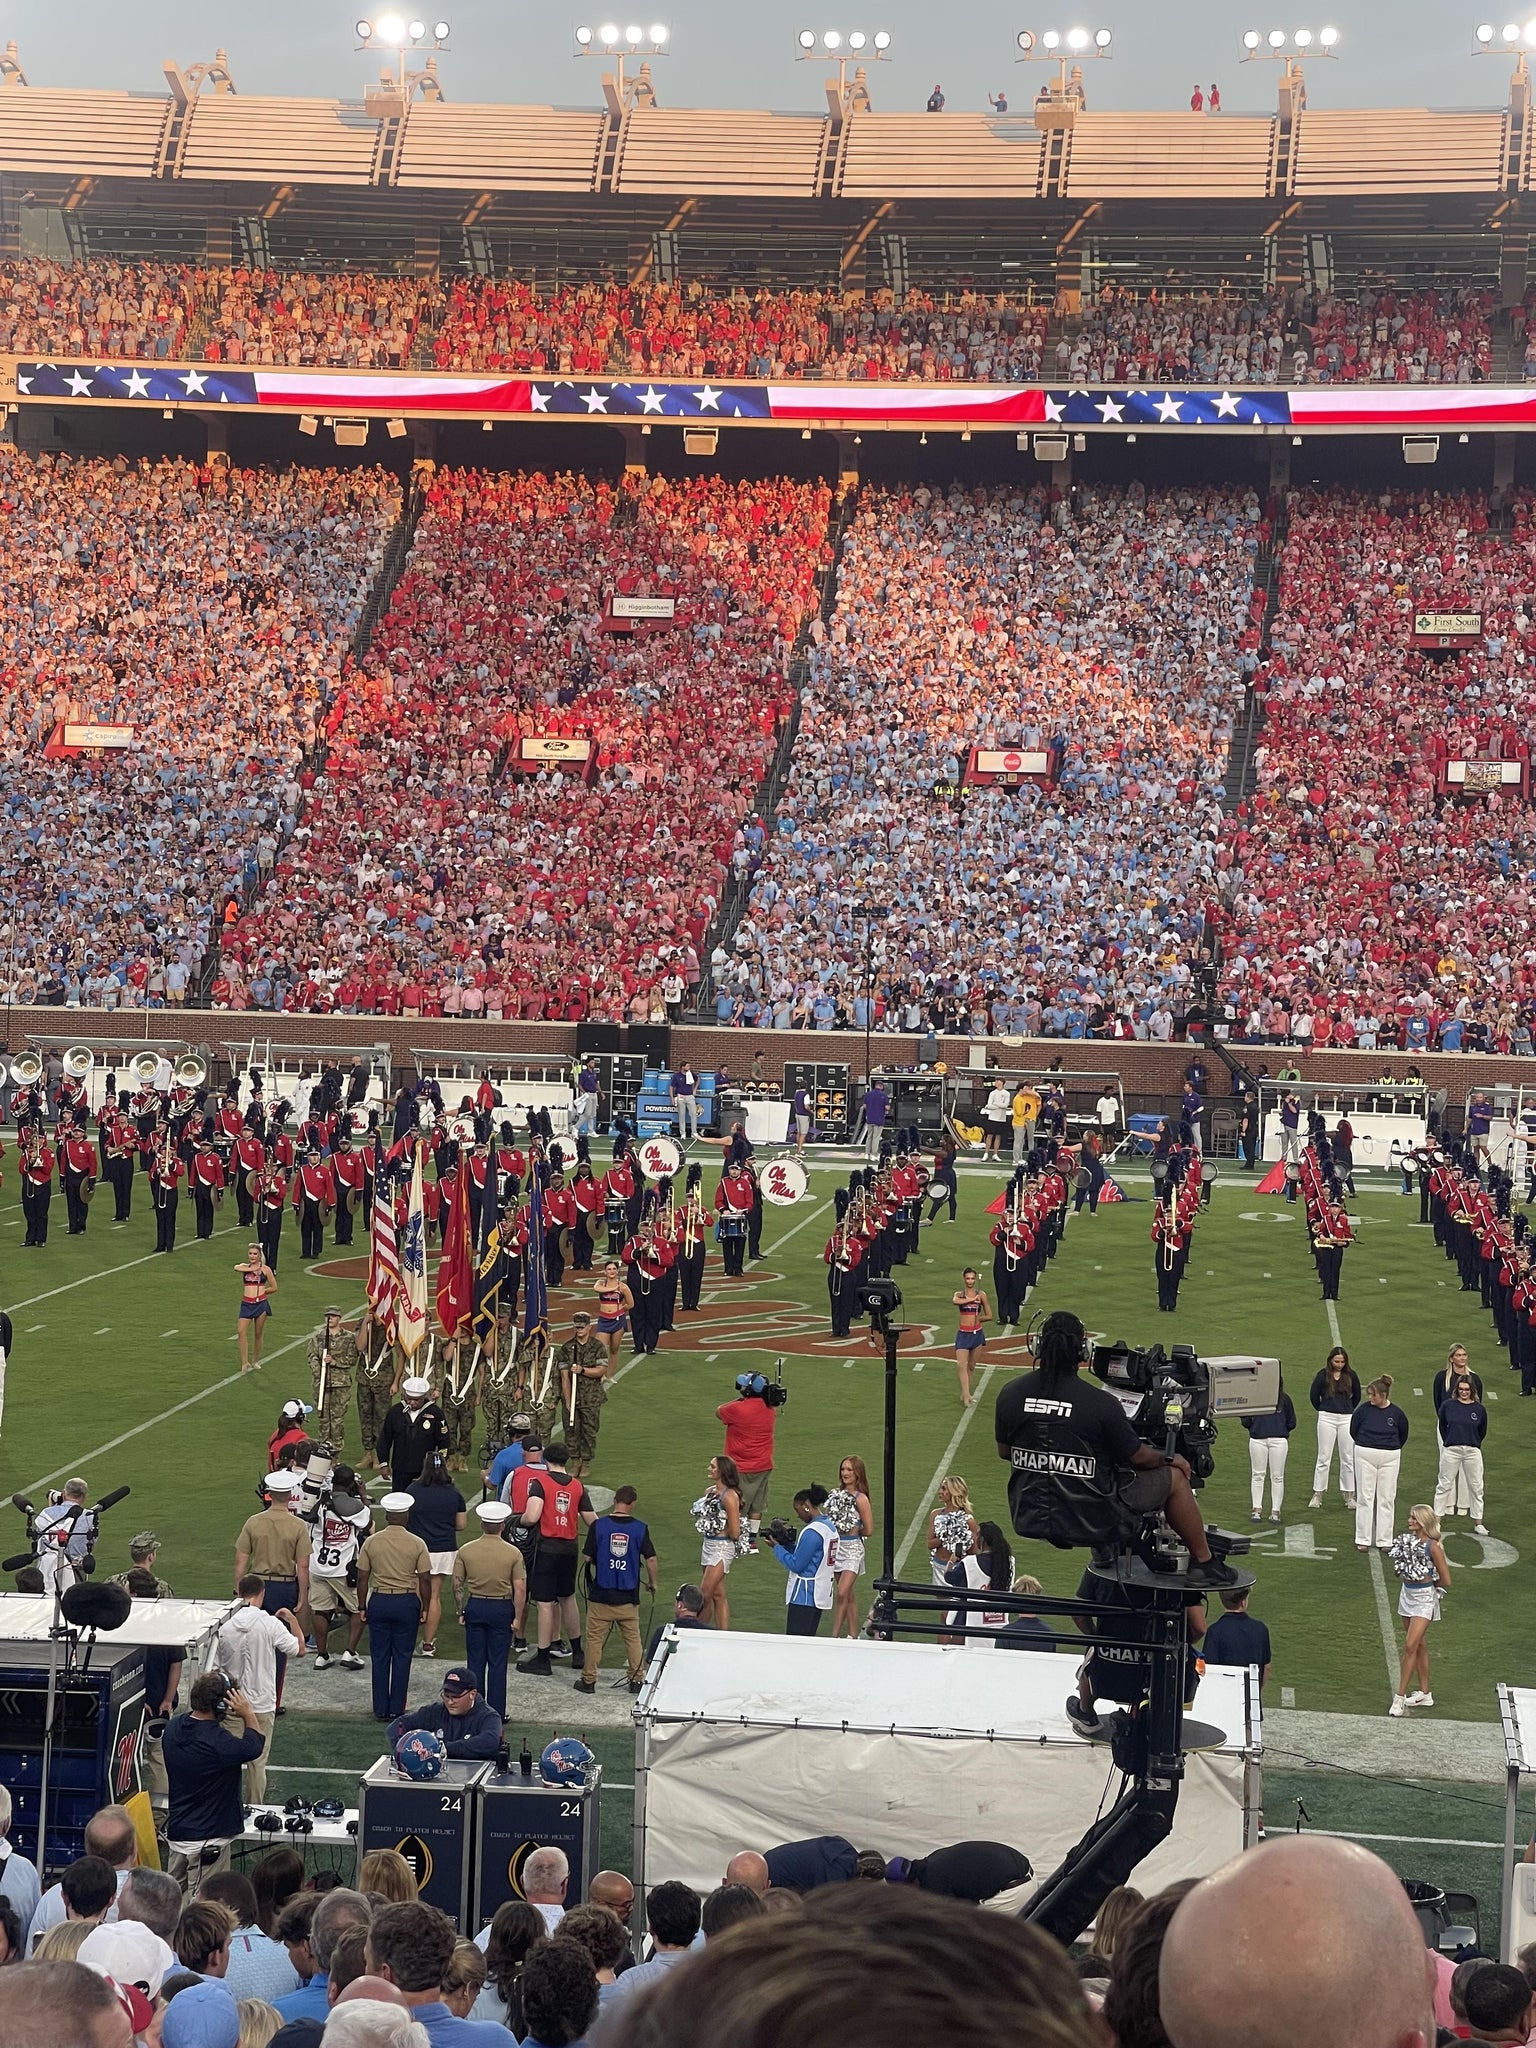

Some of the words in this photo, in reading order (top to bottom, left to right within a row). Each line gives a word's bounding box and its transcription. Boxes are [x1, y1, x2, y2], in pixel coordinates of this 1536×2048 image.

[628, 603, 670, 611] Higginbotham
[1434, 616, 1452, 626] First
[1455, 616, 1480, 626] South
[645, 1105, 679, 1113] POWERAD
[645, 1145, 660, 1159] Ole
[649, 1159, 674, 1172] Miss
[768, 1165, 787, 1181] Ole
[769, 1180, 796, 1199] Miss
[1023, 1397, 1073, 1418] ESPN
[1012, 1449, 1093, 1475] CHAPMAN
[317, 1547, 341, 1567] 83
[609, 1559, 627, 1571] 302
[440, 1796, 462, 1812] 24
[560, 1801, 581, 1817] 24
